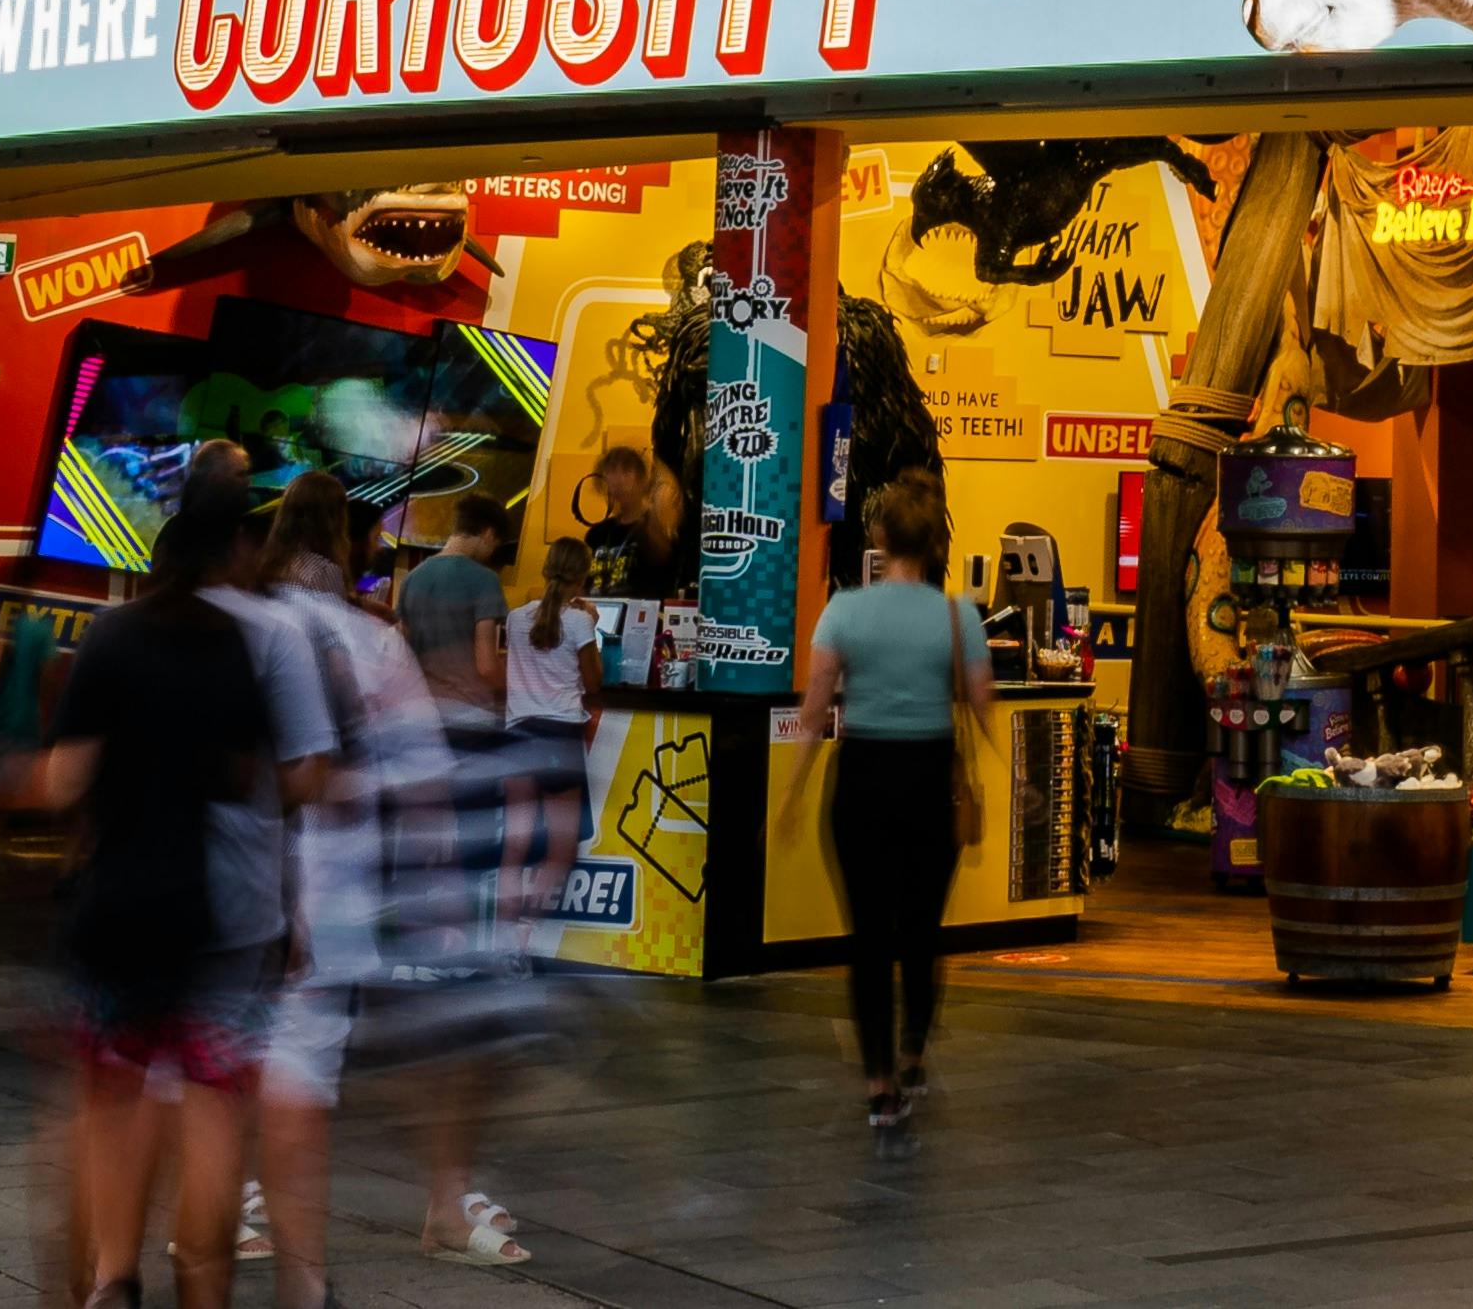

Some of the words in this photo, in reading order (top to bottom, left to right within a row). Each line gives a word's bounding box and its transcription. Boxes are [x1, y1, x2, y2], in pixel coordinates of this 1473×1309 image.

[484, 175, 561, 199] METERS
[567, 180, 628, 205] LONG!
[761, 173, 788, 200] It
[1372, 201, 1462, 244] Believe
[1058, 265, 1167, 329] JAW
[957, 392, 1000, 408] HAVE
[961, 417, 1024, 437] TEETH!
[727, 508, 781, 540] HOLD
